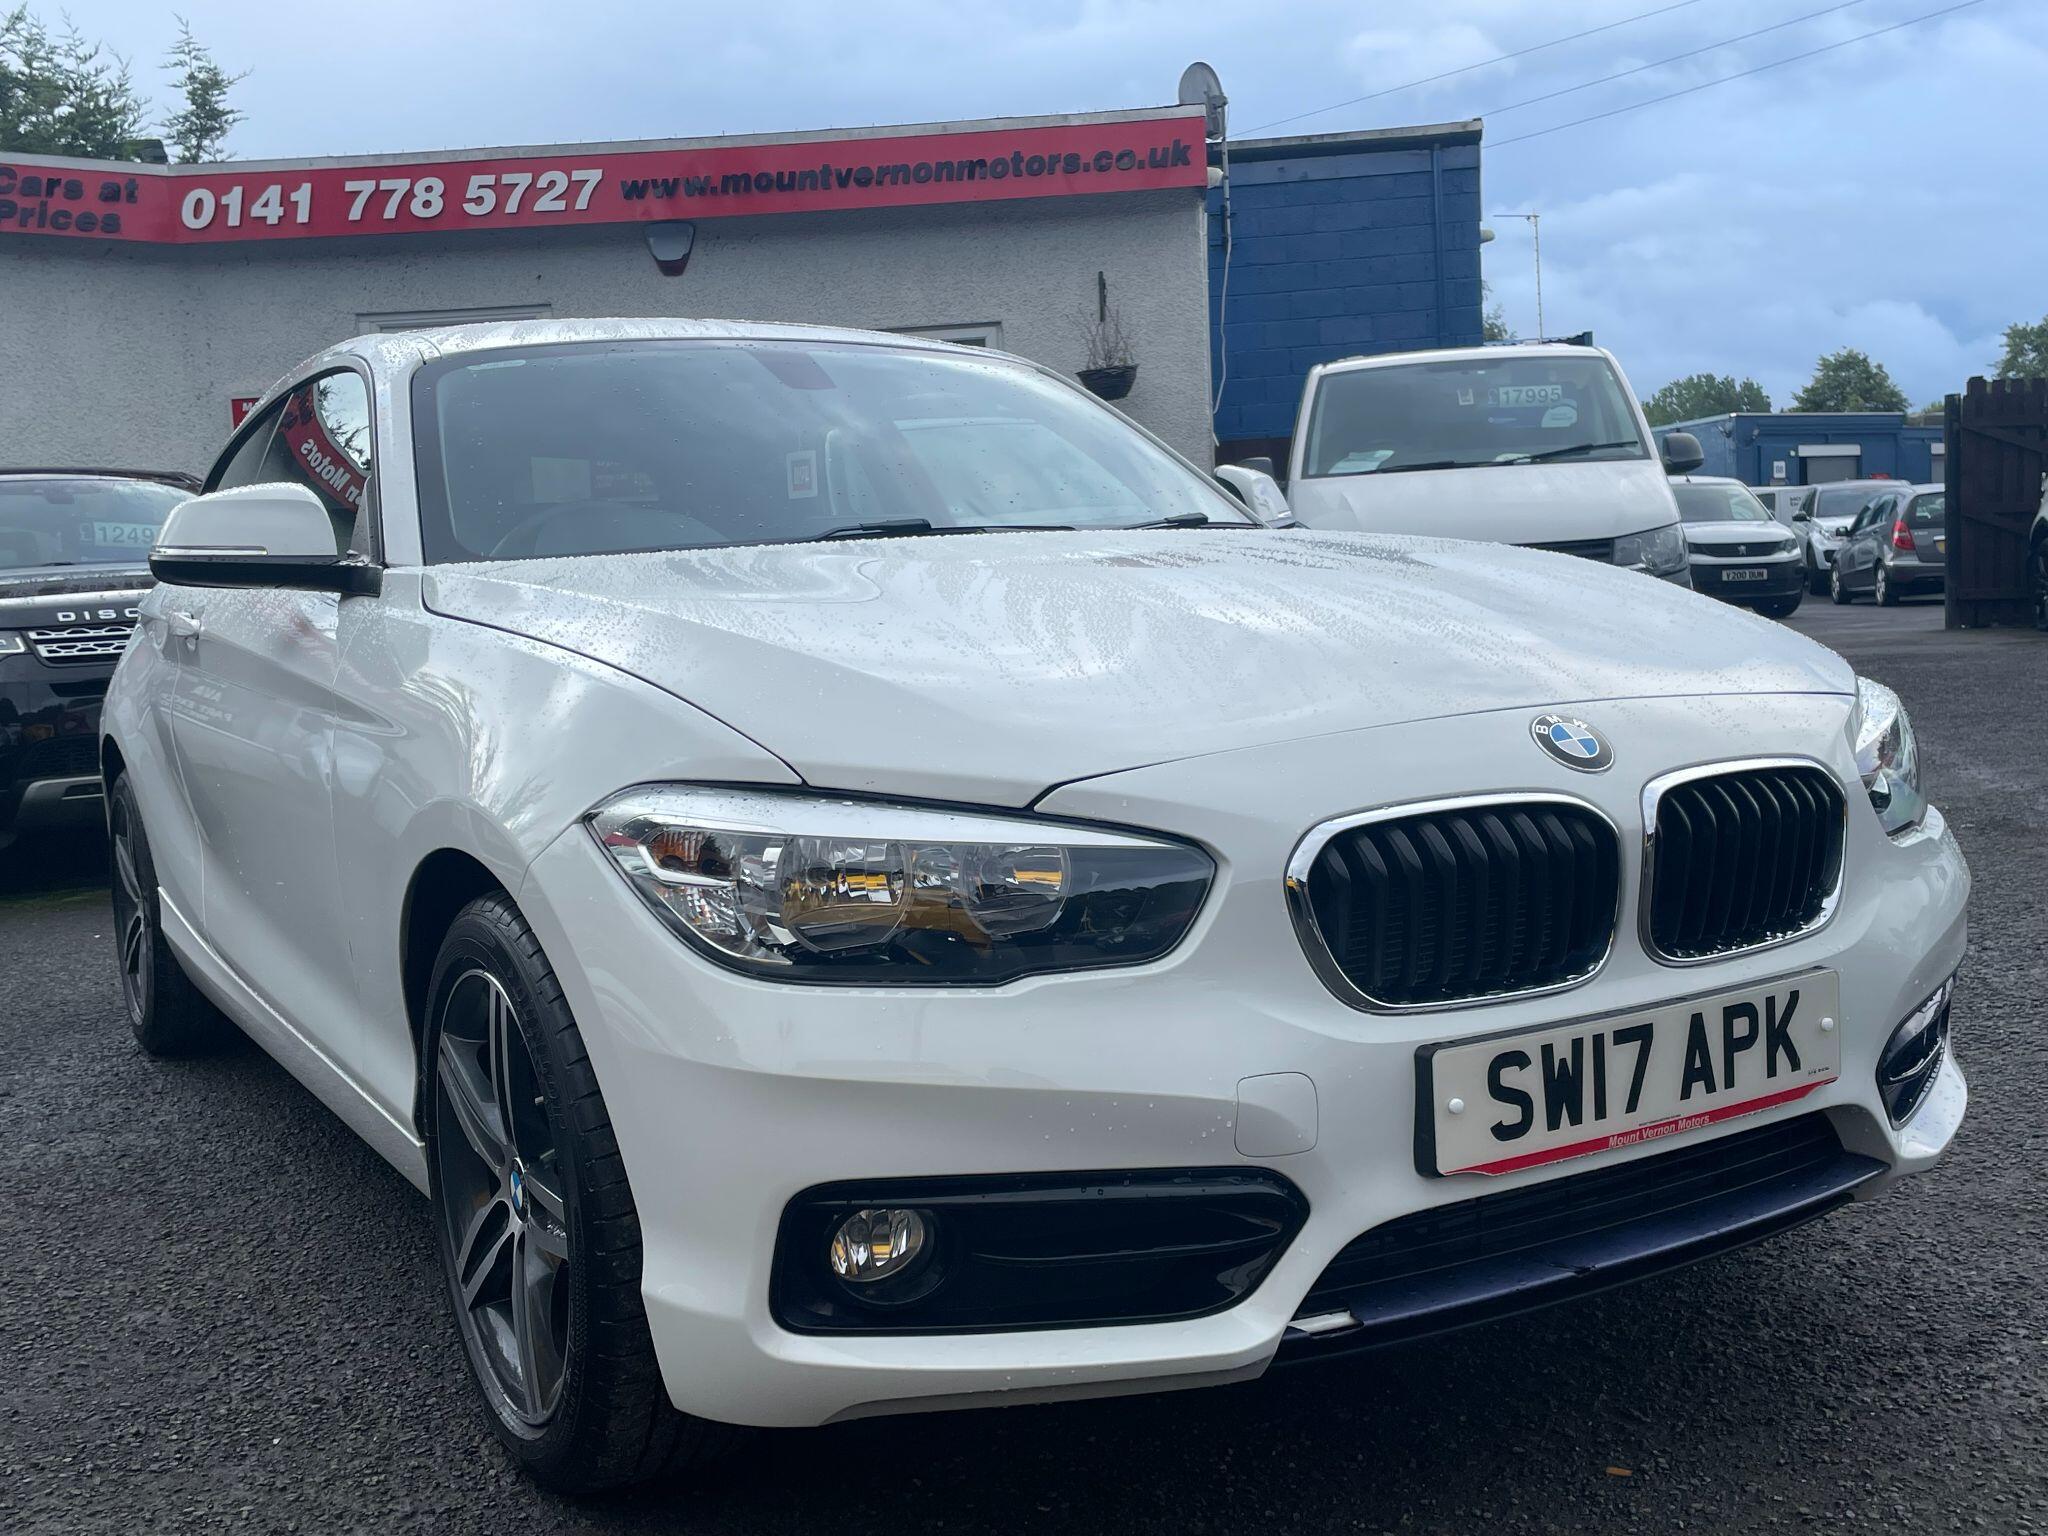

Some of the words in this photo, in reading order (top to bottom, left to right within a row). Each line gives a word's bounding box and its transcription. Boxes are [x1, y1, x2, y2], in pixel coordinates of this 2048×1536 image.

[0, 166, 84, 200] Cars
[98, 178, 139, 204] at
[181, 183, 312, 230] 0141
[344, 177, 445, 221] 778
[462, 169, 603, 216] 5727
[620, 139, 1192, 200] www.mountvernonmotors.co.uk
[1487, 1022, 1654, 1142] SW17
[1680, 989, 1801, 1101] APK
[1608, 1131, 1640, 1148] Mount
[1641, 1124, 1676, 1139] Vernon
[1677, 1115, 1710, 1132] Motors
